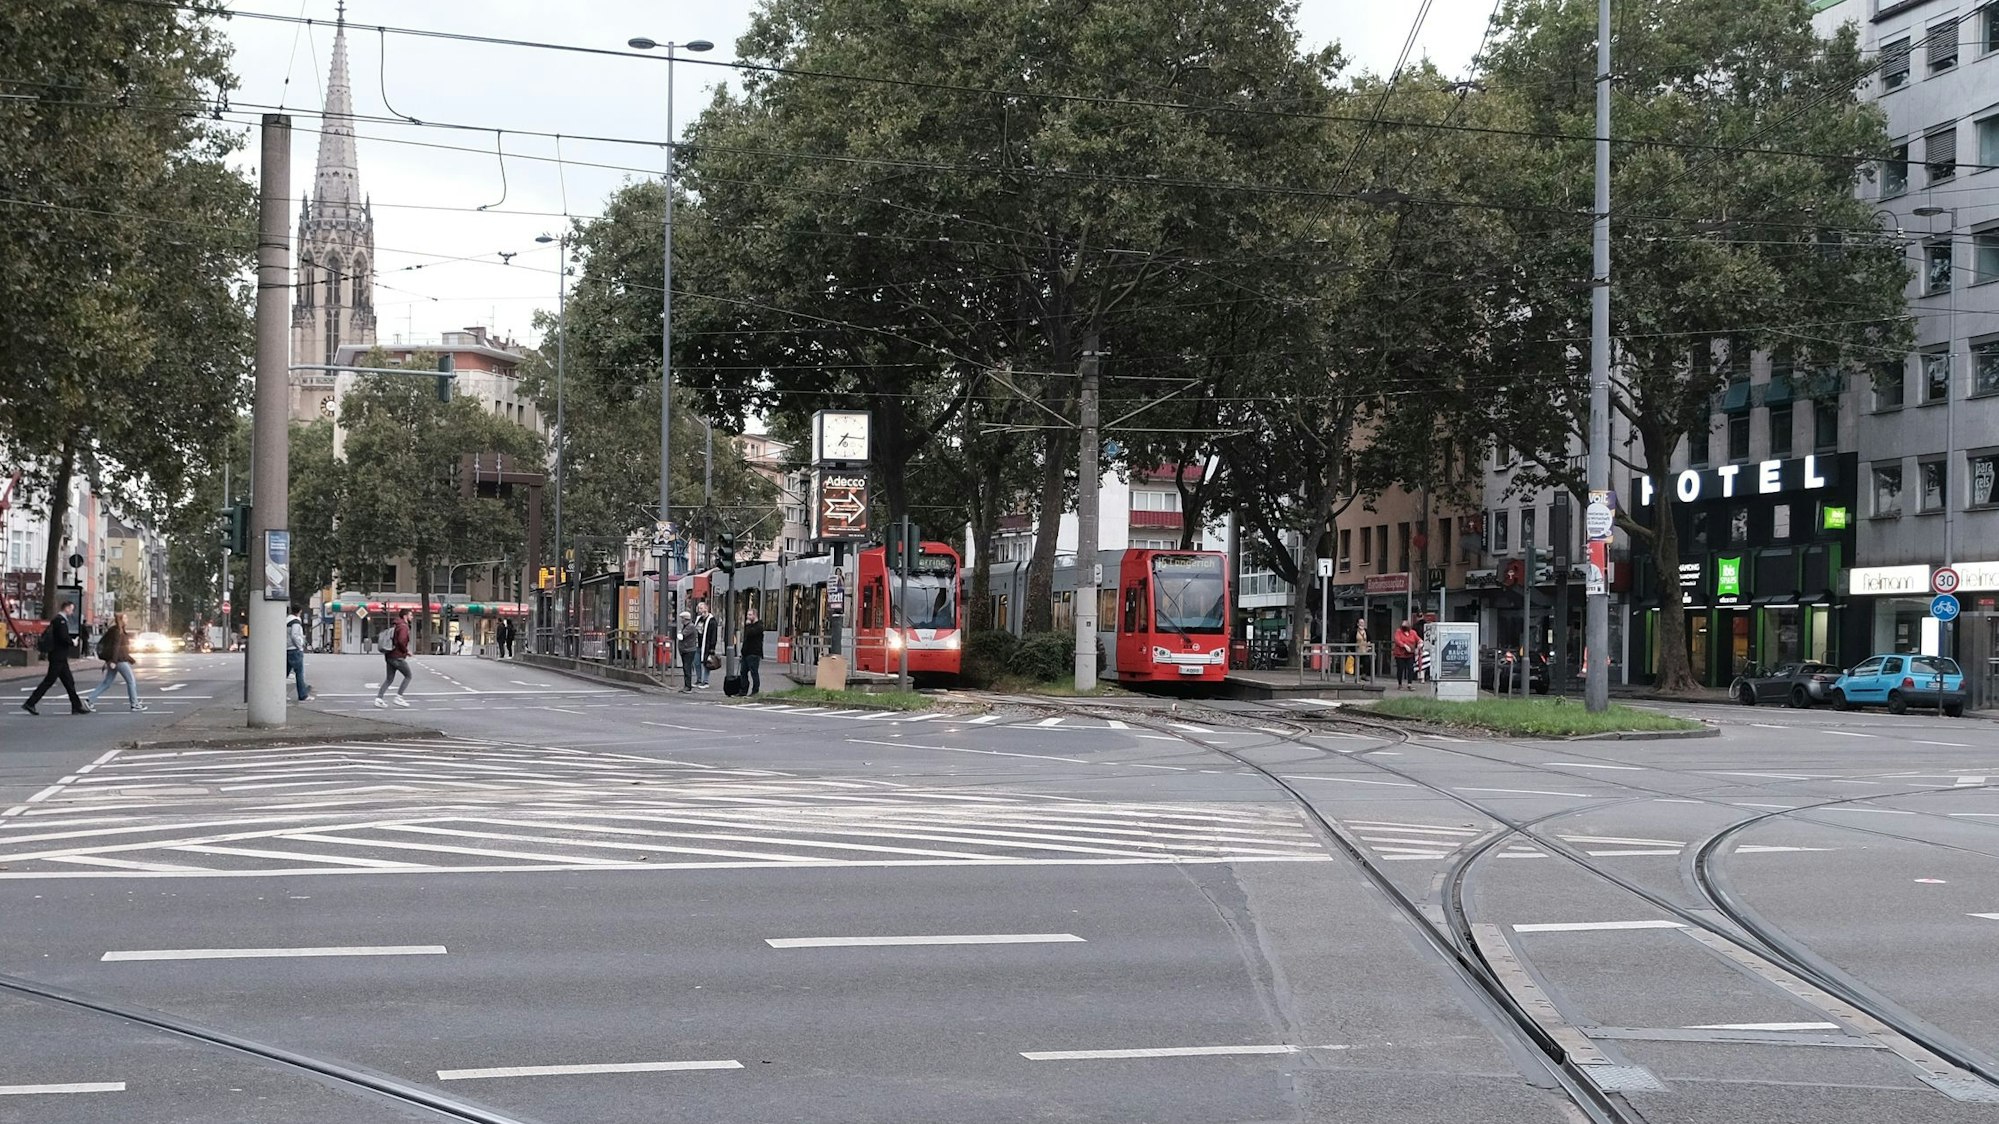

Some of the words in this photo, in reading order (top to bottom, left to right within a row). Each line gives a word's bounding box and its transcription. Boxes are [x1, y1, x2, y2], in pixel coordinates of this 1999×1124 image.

[826, 475, 865, 487] Adecco
[1641, 455, 1825, 506] HOTEL
[1588, 492, 1609, 504] Volt
[1170, 558, 1215, 569] Longerich
[1323, 564, 1328, 575] 1
[1938, 575, 1955, 587] 30
